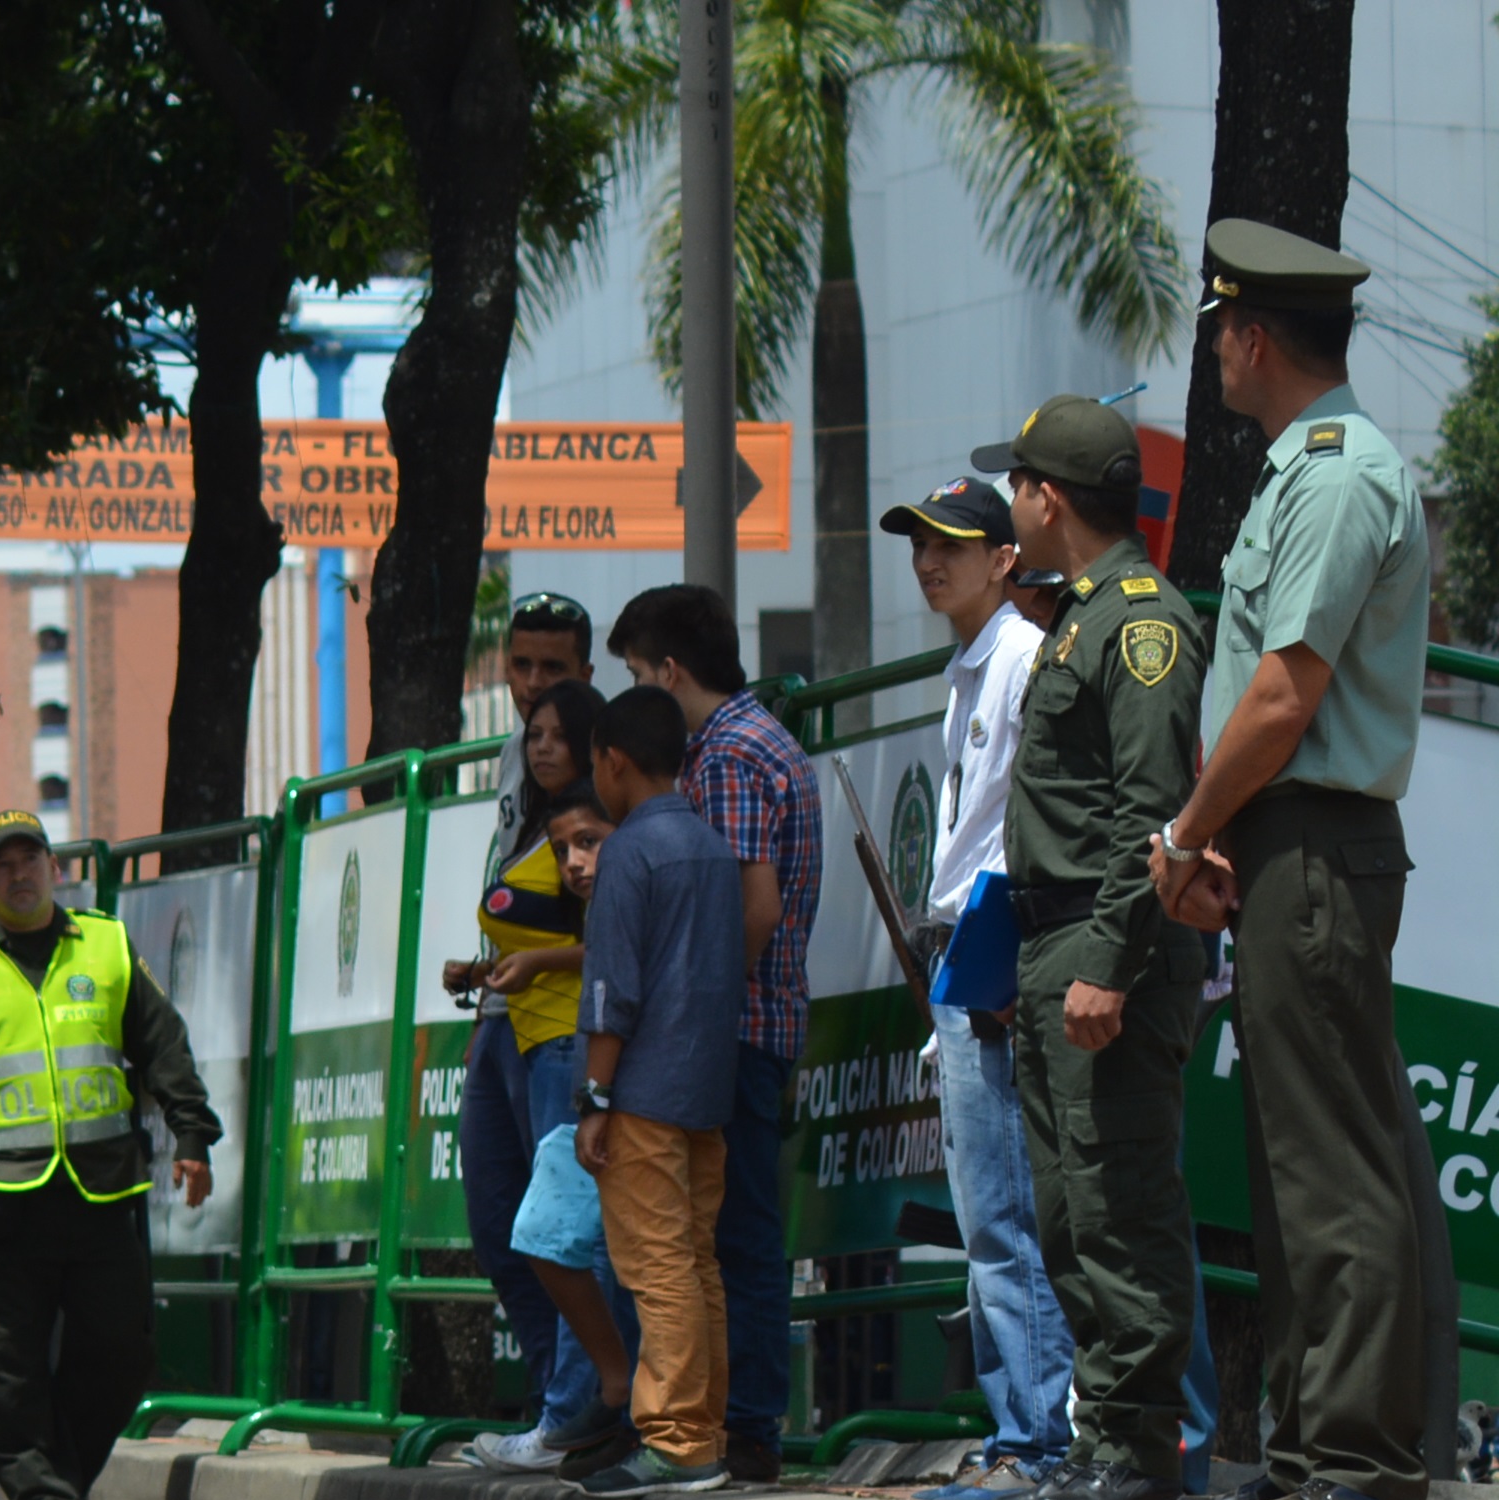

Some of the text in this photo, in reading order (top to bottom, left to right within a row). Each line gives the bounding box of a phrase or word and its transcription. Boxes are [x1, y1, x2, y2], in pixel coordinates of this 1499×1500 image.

[89, 496, 194, 533] GONZAL
[272, 503, 346, 536] ENCIA
[501, 504, 530, 538] LA
[538, 506, 616, 539] FLORA
[420, 1066, 468, 1118] POLIC
[794, 1043, 880, 1122] POLICÍA
[301, 1137, 318, 1183] DE
[430, 1130, 453, 1181] DE
[817, 1116, 947, 1189] DE COLOMB
